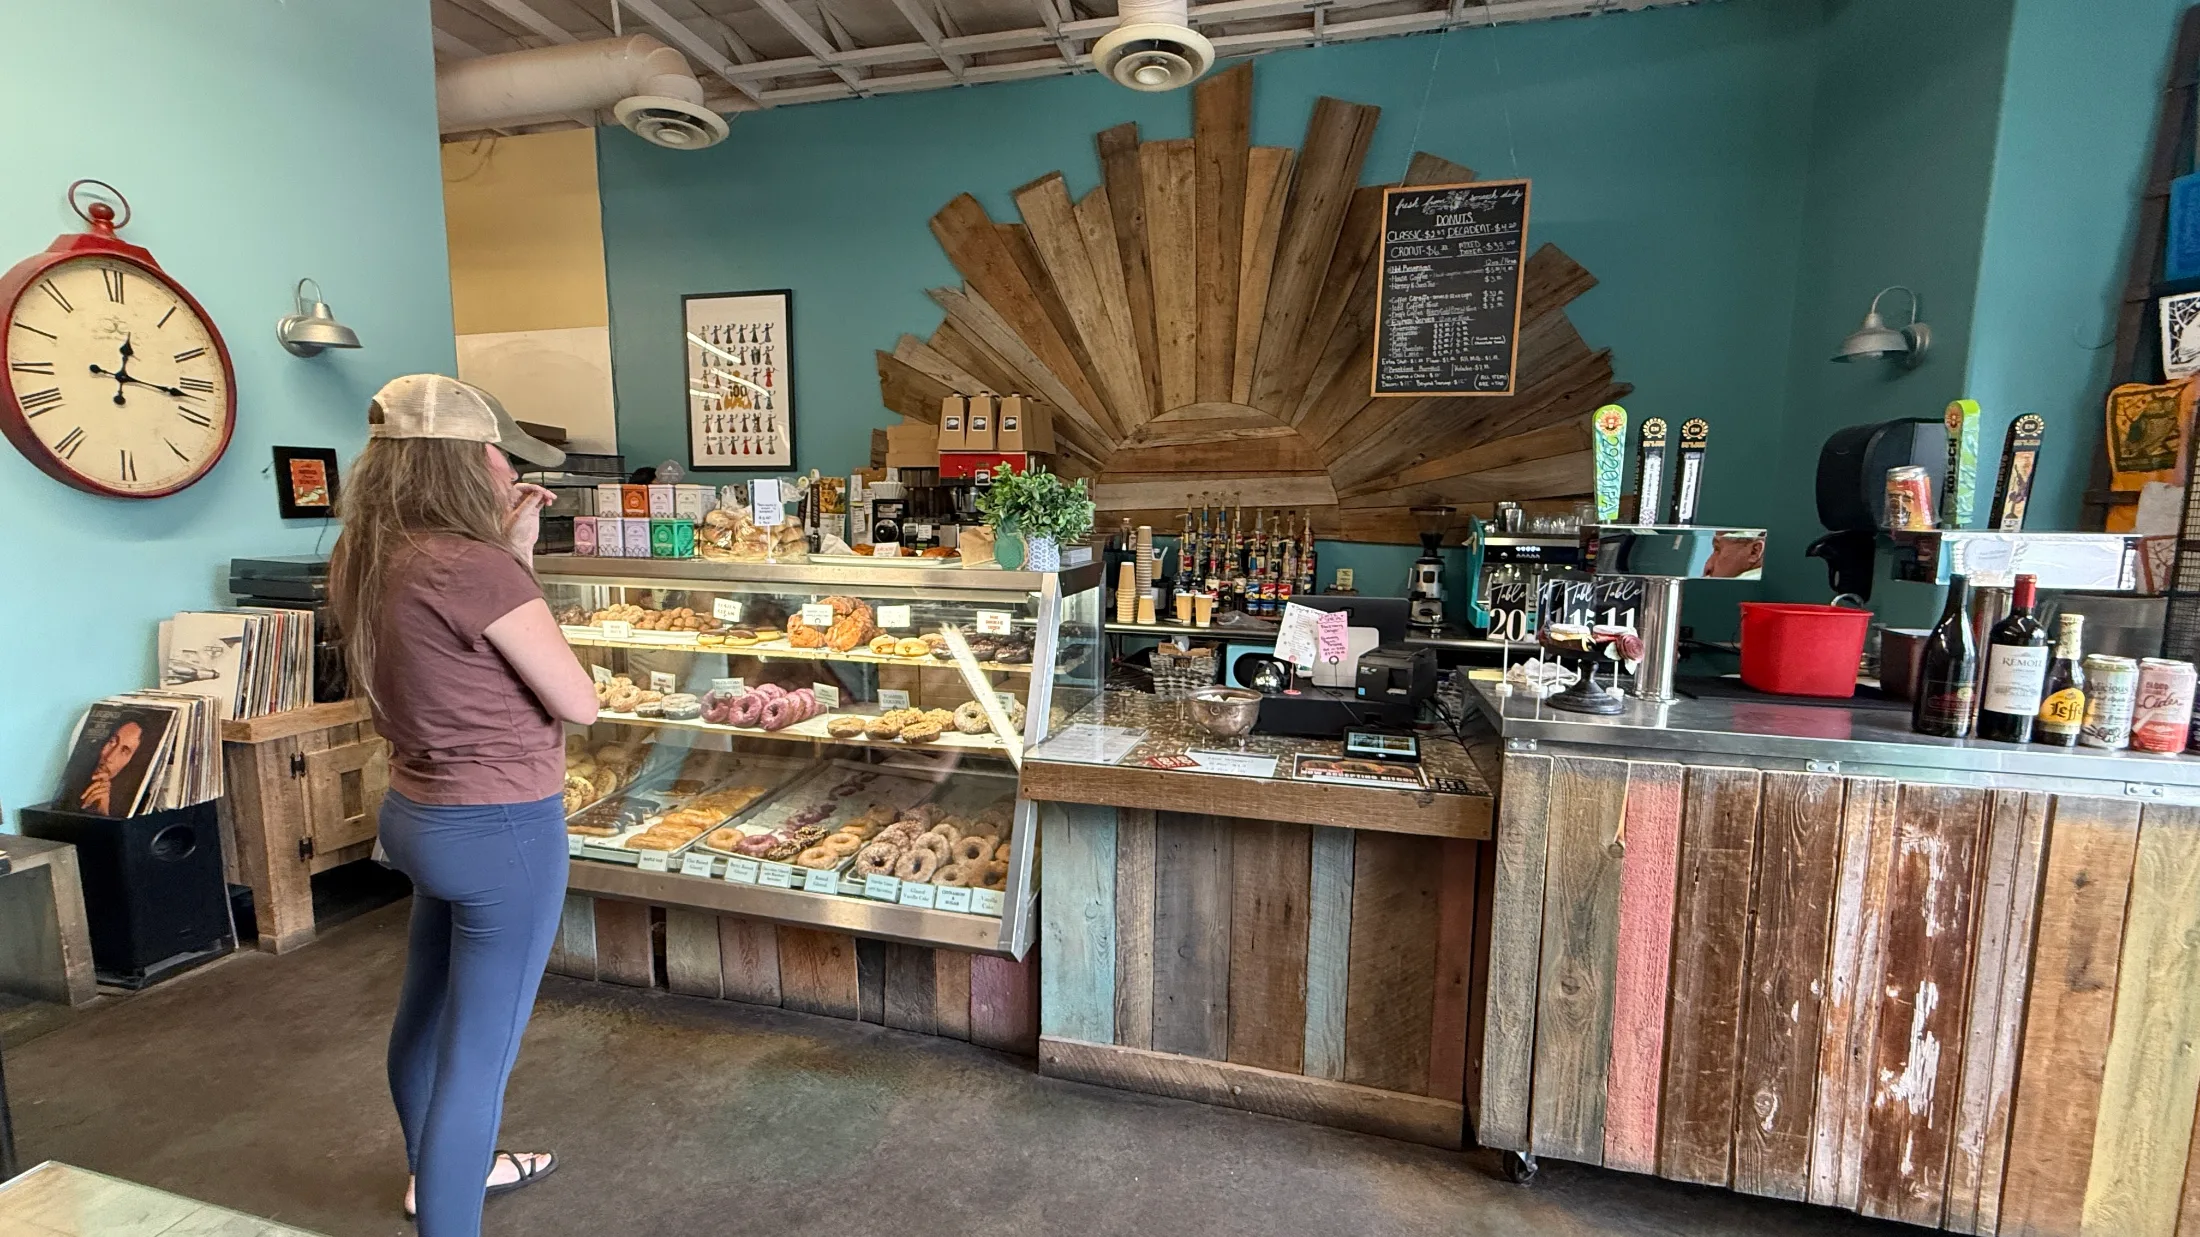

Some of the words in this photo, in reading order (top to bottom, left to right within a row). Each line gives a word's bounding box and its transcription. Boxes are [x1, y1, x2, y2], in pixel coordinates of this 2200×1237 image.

[1394, 197, 1420, 216] fresh
[1436, 211, 1474, 226] DONUTS
[180, 377, 214, 393] III
[1490, 582, 1527, 605] Table
[1595, 580, 1643, 602] Table
[1488, 607, 1527, 642] 20
[1601, 607, 1635, 627] 11
[2050, 700, 2083, 722] Leffe
[910, 887, 926, 895] Glazed
